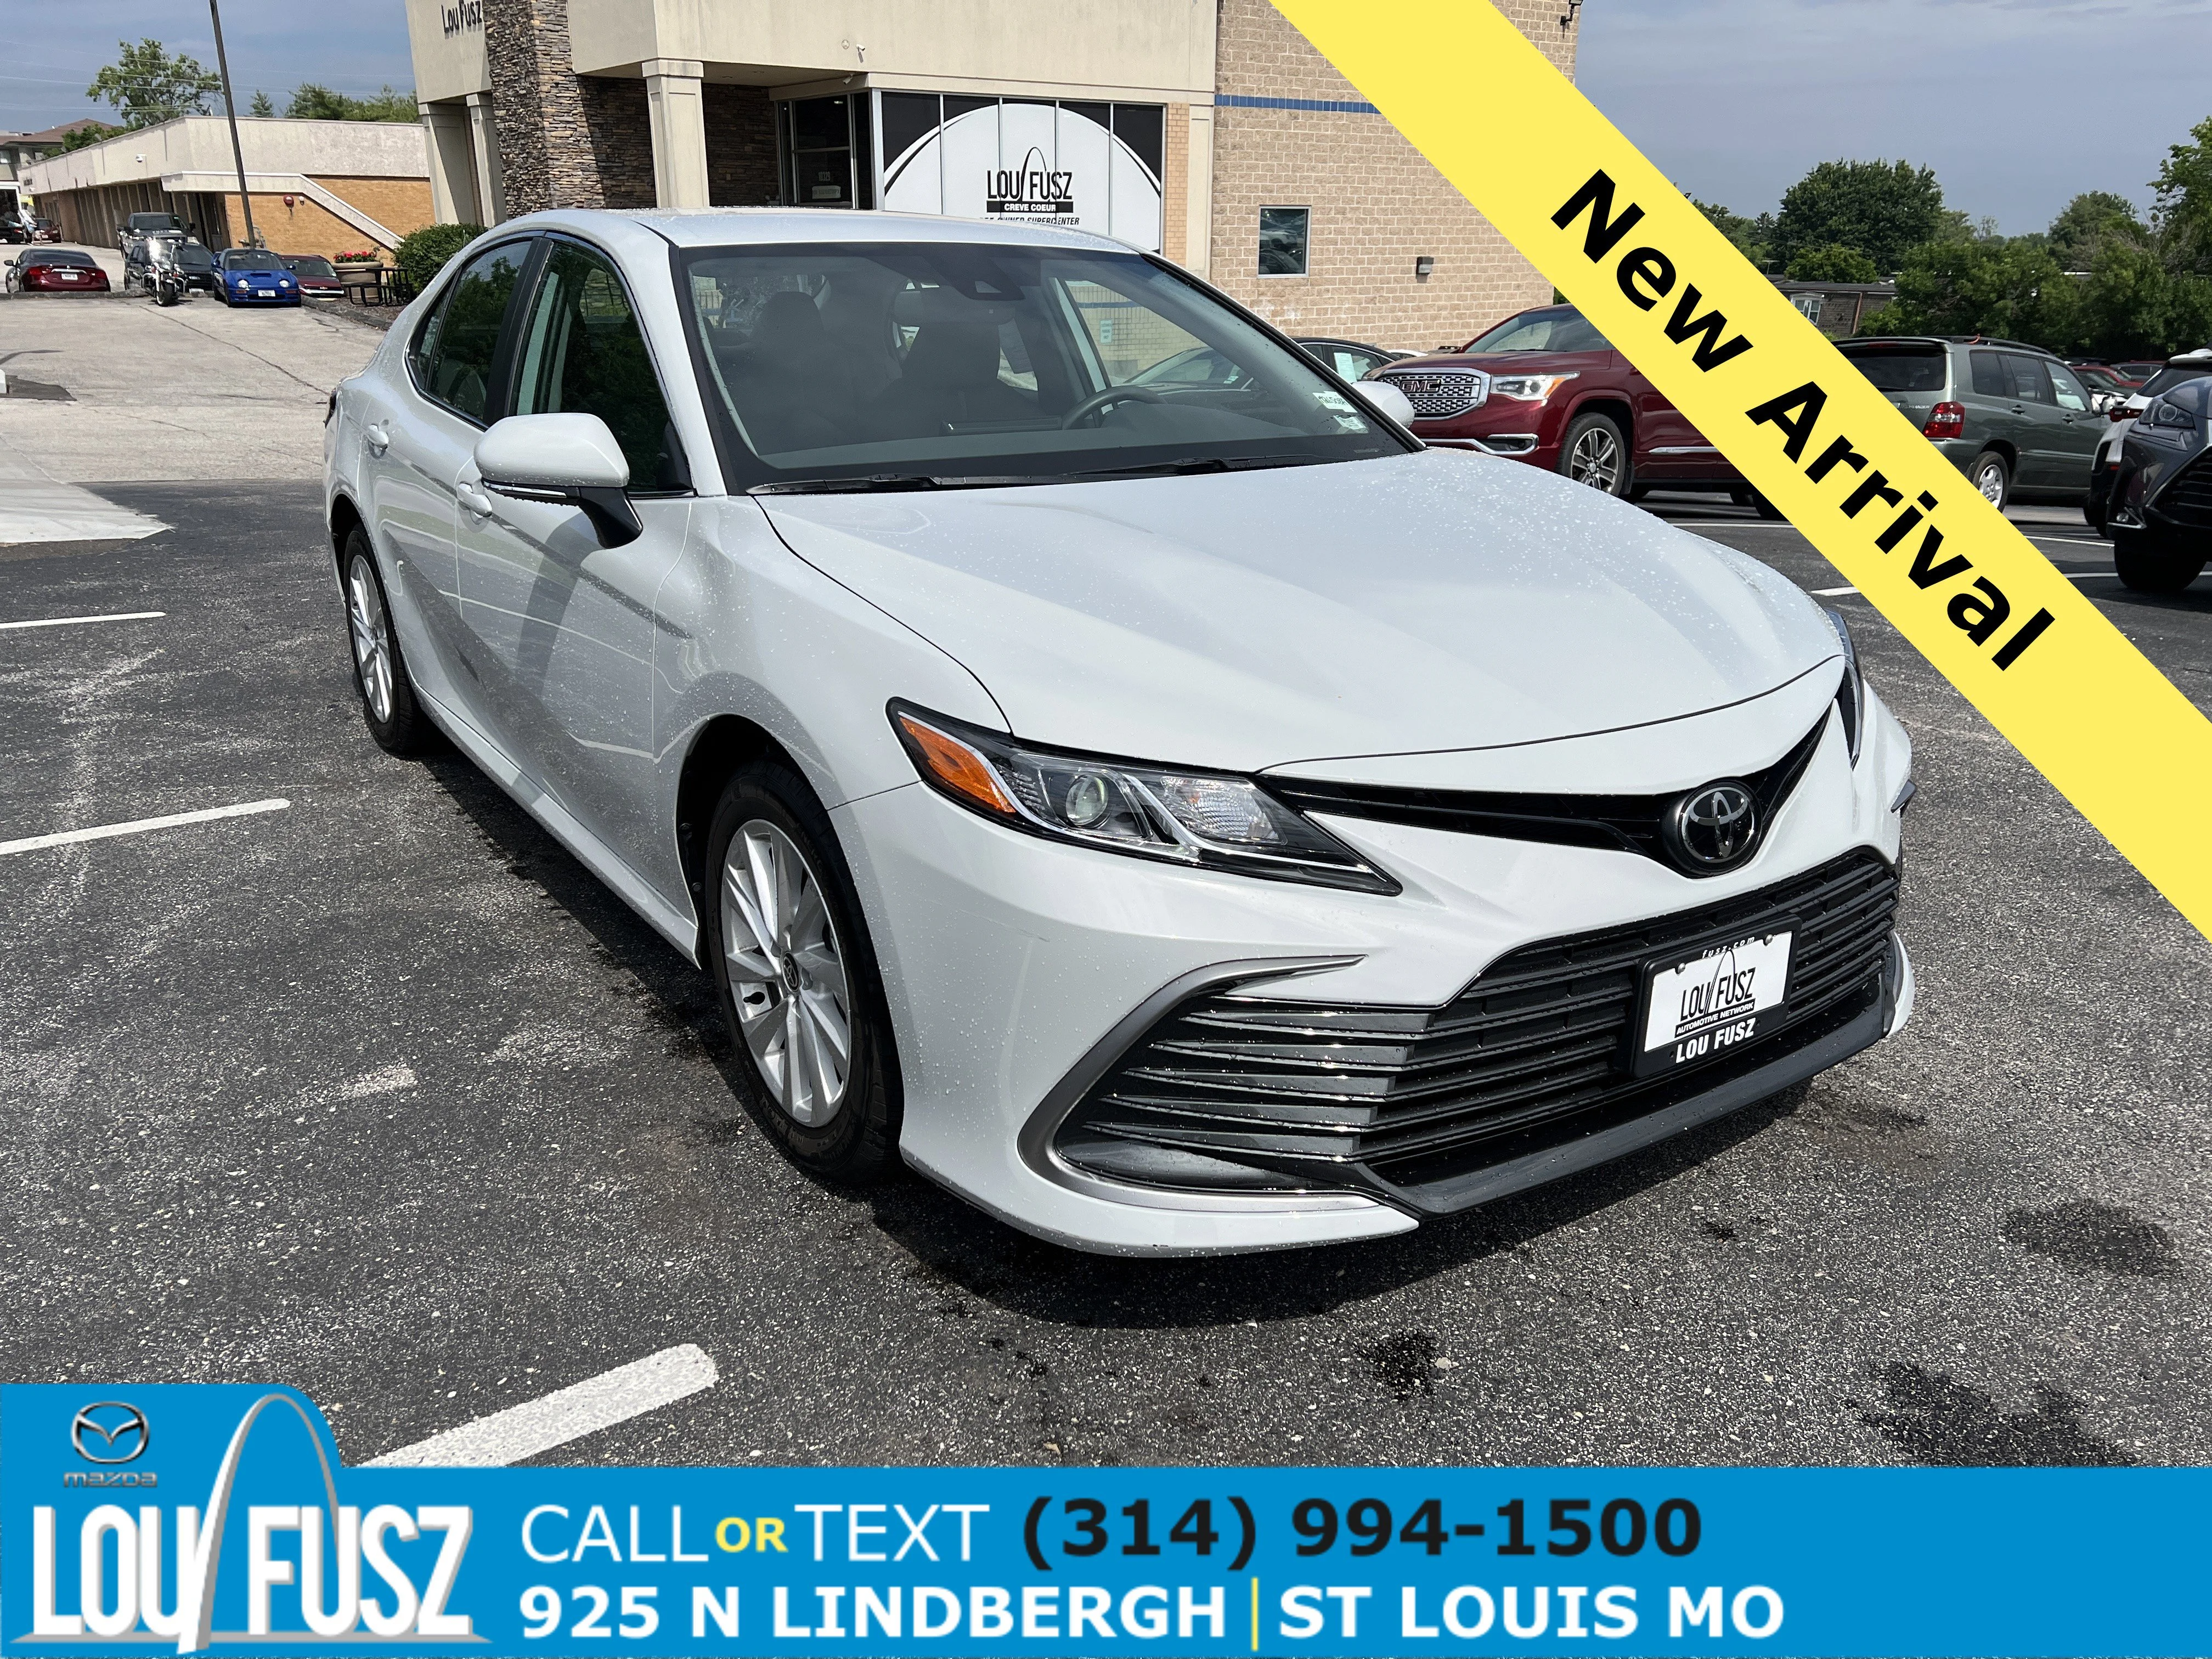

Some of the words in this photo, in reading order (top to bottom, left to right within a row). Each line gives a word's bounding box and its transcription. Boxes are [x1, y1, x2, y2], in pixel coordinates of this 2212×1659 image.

[987, 170, 1020, 199] LOU
[1029, 171, 1073, 200] FUSZ
[1004, 203, 1029, 212] CREVE
[1030, 204, 1056, 212] COEUR
[1400, 380, 1440, 392] GMC
[1702, 936, 1755, 959] fusz.com
[1680, 981, 1711, 1022] LOU
[1715, 967, 1756, 1009] FUSZ
[1676, 1013, 1719, 1035] AUTOMOTIVE
[1720, 1002, 1754, 1019] NETWORK
[1675, 1034, 1709, 1063] LOU
[1713, 1017, 1756, 1050] FUSZ
